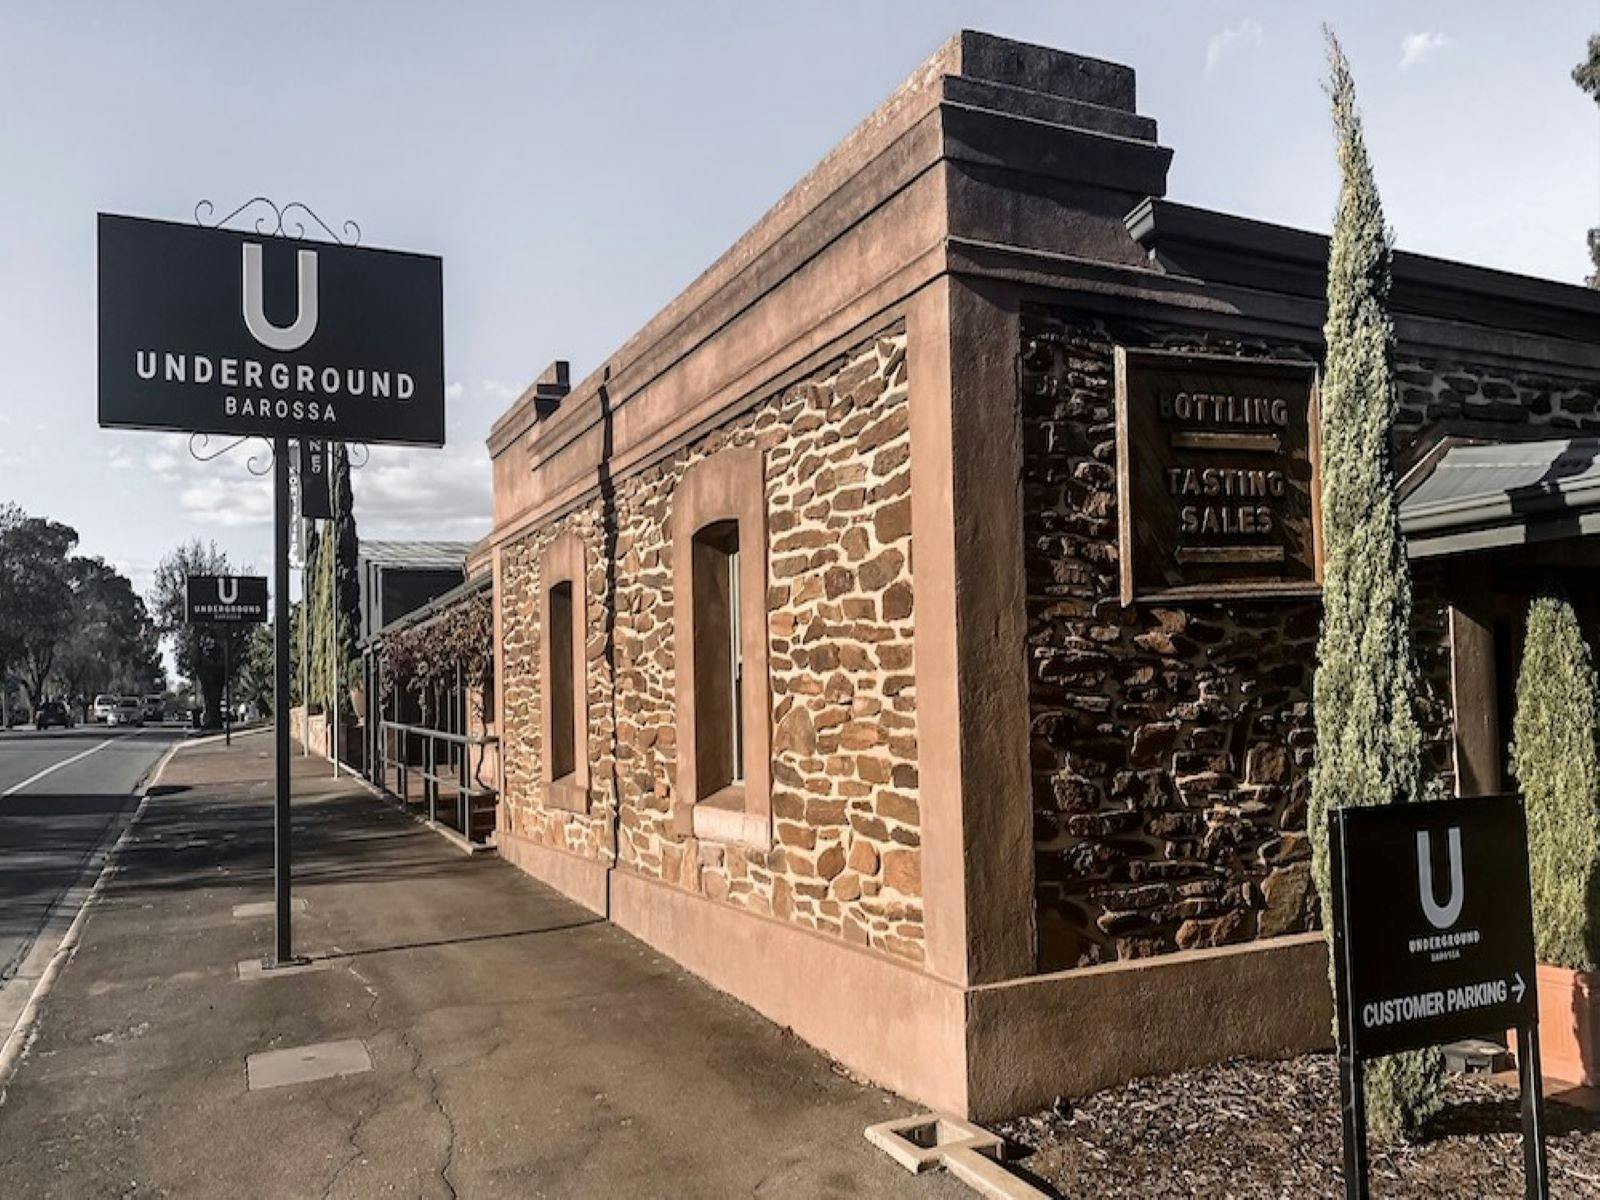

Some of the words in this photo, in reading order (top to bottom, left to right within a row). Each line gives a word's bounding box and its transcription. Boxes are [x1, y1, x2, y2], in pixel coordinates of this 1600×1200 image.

[242, 242, 318, 350] U
[136, 351, 414, 400] UNDERGROUND
[225, 396, 336, 422] BAROSSA
[1159, 393, 1288, 426] BOTTLING
[1168, 468, 1285, 497] TASTING
[1181, 505, 1273, 534] SALES
[217, 578, 239, 604] U
[1416, 827, 1464, 929] U
[1408, 930, 1480, 953] UNDERGROUND
[1363, 992, 1445, 1028] CUSTOMER
[1448, 980, 1508, 1012] PARKING
